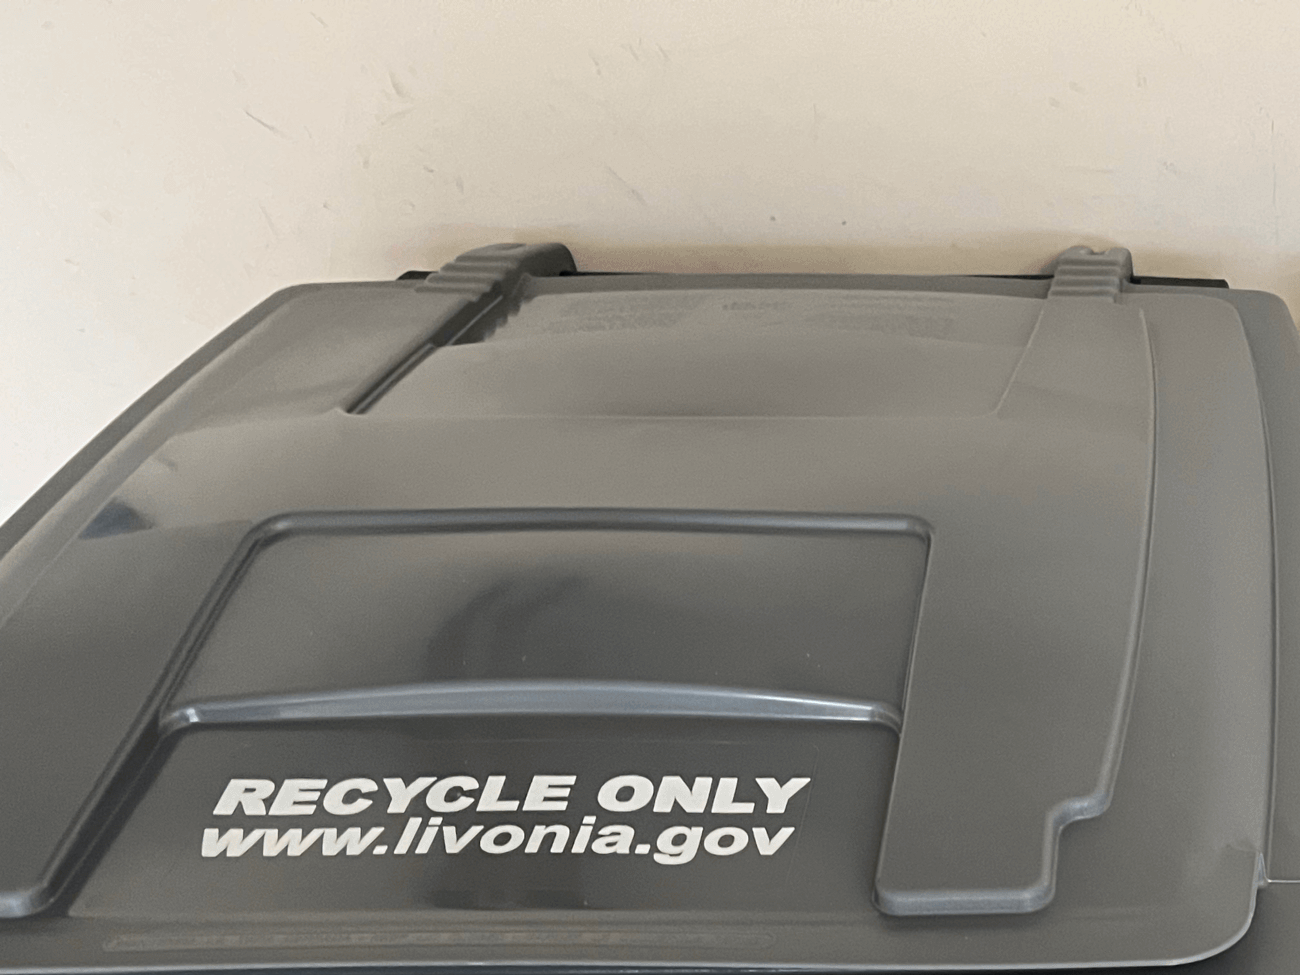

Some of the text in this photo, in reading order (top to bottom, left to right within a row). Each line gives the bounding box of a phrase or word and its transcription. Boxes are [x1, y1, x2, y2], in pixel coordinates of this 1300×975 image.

[212, 774, 811, 816] RECYCLE ONLY
[201, 815, 796, 866] www.livonia.gov
